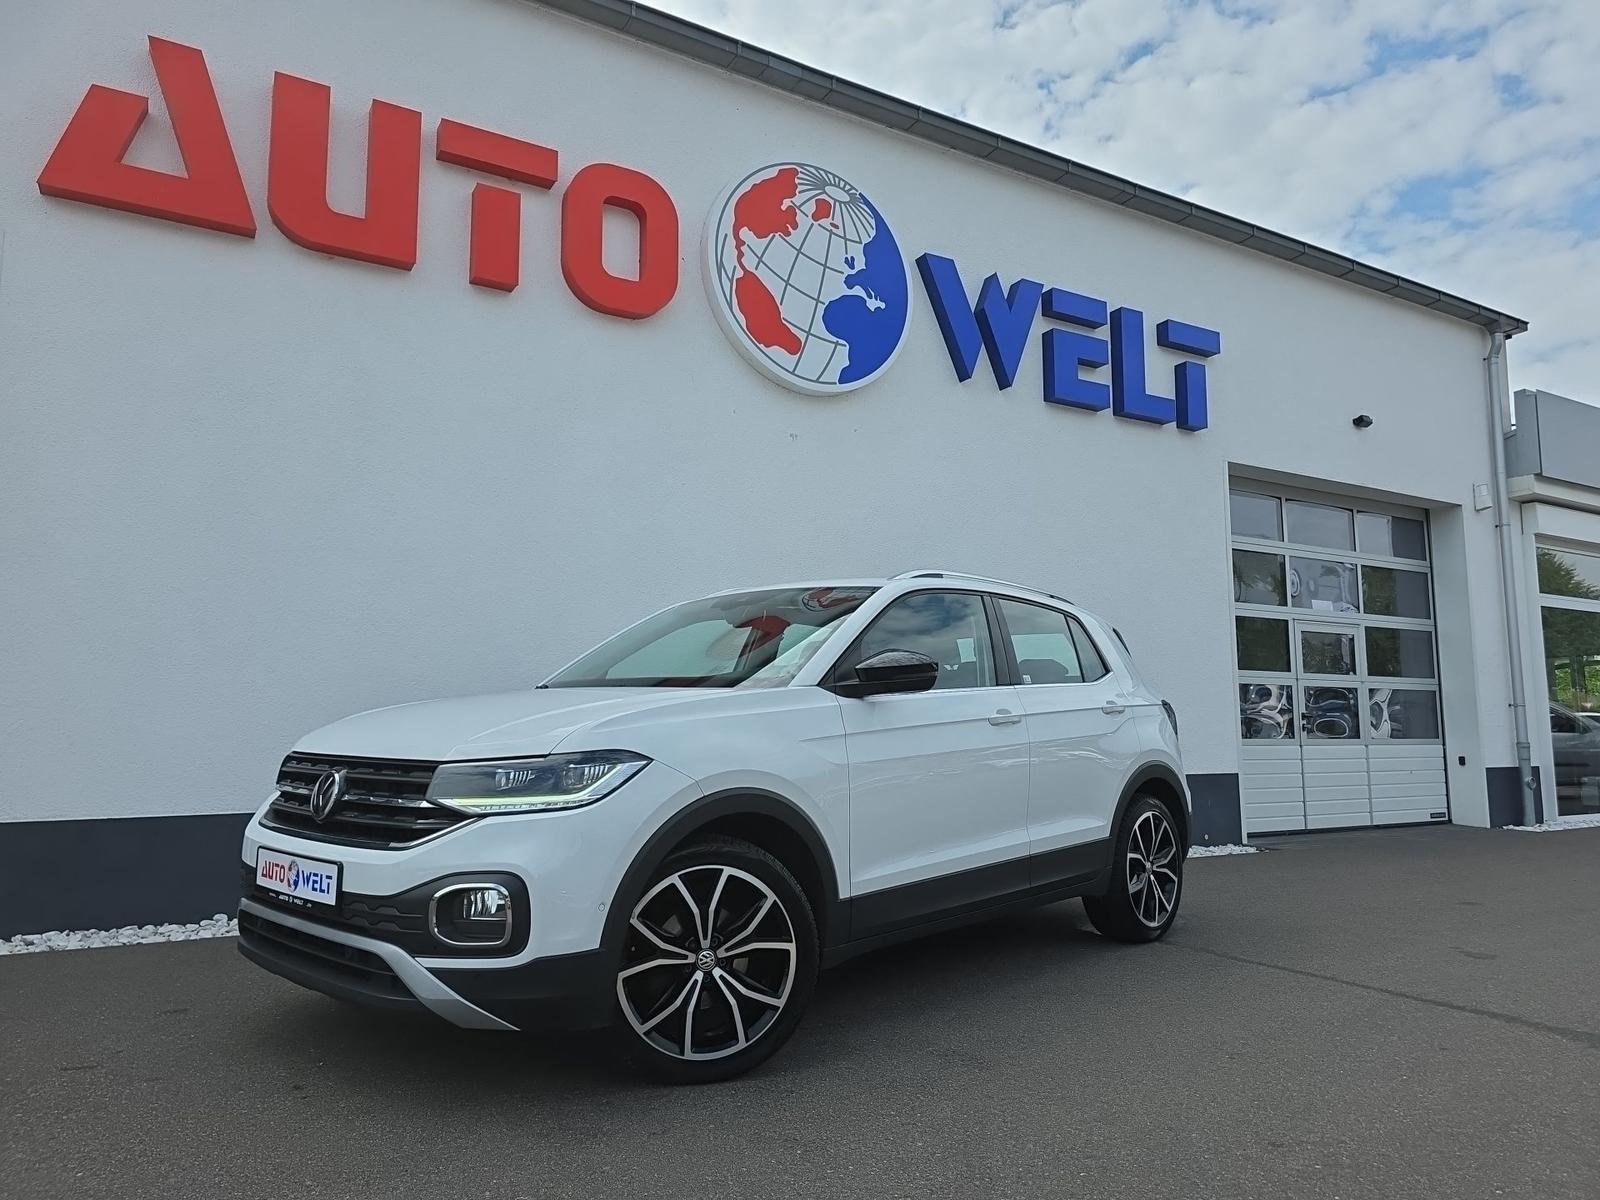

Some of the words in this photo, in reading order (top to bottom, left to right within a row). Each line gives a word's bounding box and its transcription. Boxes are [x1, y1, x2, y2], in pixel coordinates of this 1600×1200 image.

[37, 35, 678, 320] AUTO
[916, 252, 1221, 432] WELT
[261, 860, 286, 884] AUTO
[301, 869, 333, 895] WELT
